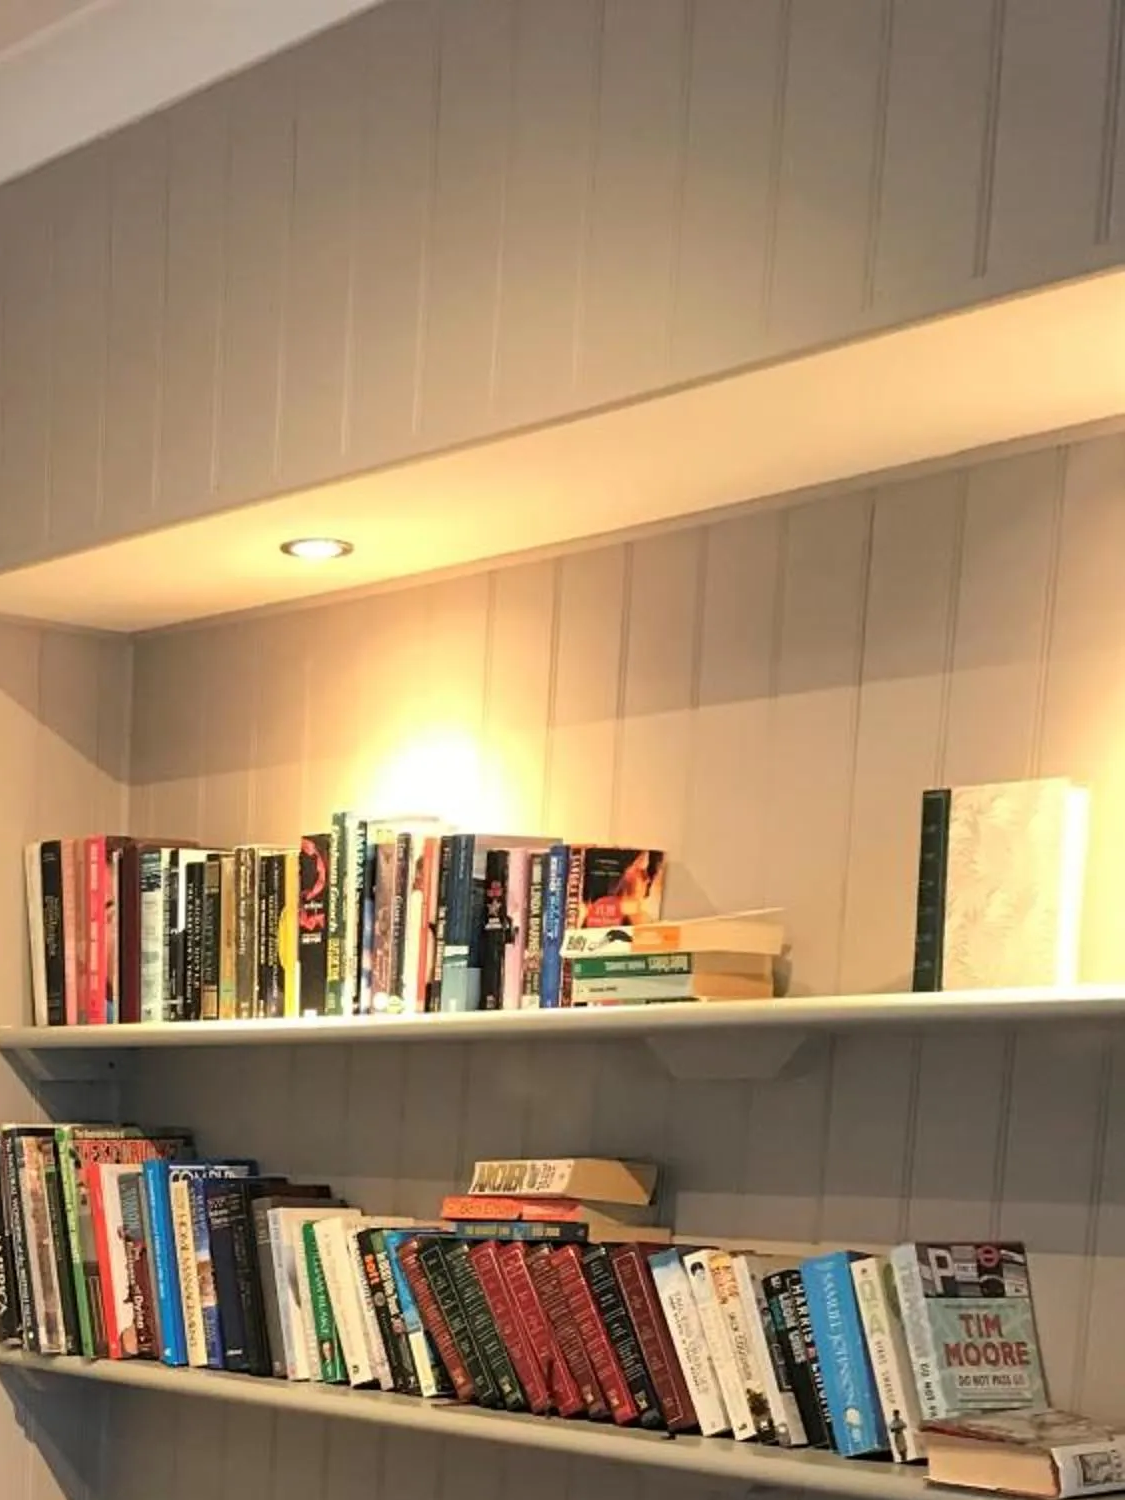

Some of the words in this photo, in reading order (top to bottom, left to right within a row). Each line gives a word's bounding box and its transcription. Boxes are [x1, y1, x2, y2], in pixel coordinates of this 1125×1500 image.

[959, 1313, 1004, 1338] TIM
[943, 1341, 1031, 1367] MOORE
[973, 1376, 989, 1386] NOT
